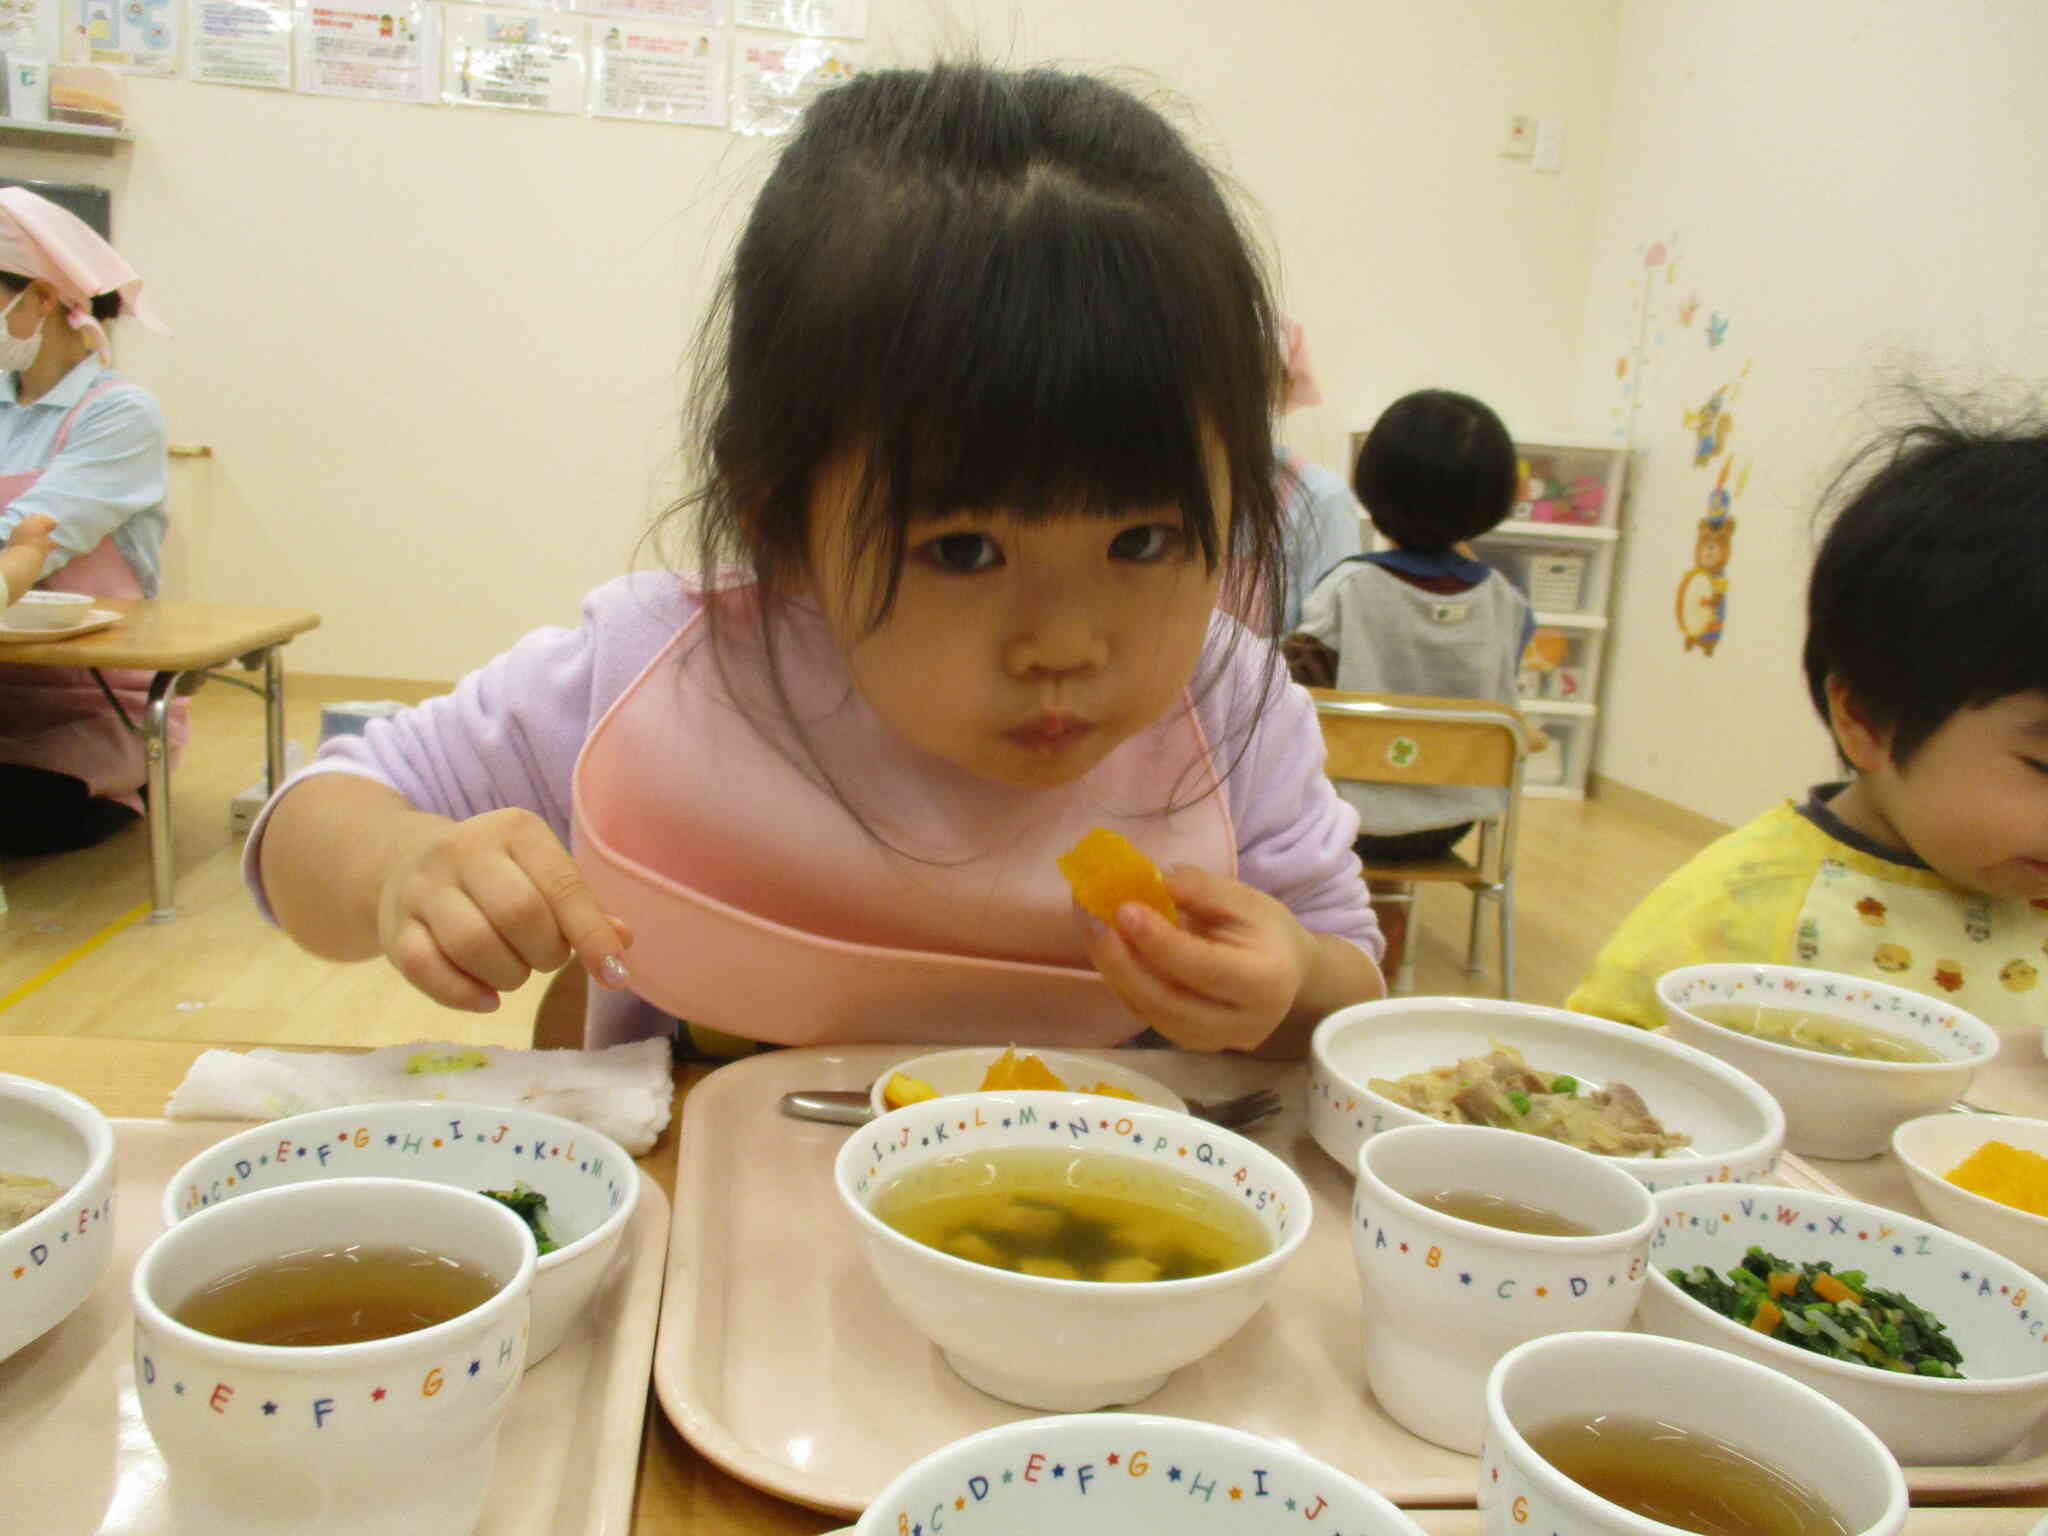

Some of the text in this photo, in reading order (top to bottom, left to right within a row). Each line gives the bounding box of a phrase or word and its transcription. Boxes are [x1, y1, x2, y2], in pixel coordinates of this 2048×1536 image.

[235, 1160, 251, 1179] D
[276, 1140, 292, 1162] E
[317, 1144, 332, 1167] F
[353, 1128, 370, 1148] G
[402, 1133, 423, 1153] H
[449, 1120, 464, 1140] I
[491, 1124, 511, 1144] J
[534, 1141, 547, 1160] K
[565, 1139, 577, 1160] L
[901, 1128, 910, 1148] J
[936, 1122, 949, 1144] K
[975, 1107, 988, 1126] L
[1019, 1106, 1038, 1126] M
[1068, 1117, 1089, 1139] N
[1115, 1118, 1133, 1135] O
[1154, 1137, 1168, 1152] P
[1196, 1143, 1213, 1165] Q
[1232, 1167, 1248, 1186] R
[1256, 1191, 1267, 1210] S
[30, 1244, 48, 1266] D
[79, 1209, 88, 1233] E
[1375, 1228, 1641, 1299] A B C D E
[1673, 1211, 1688, 1229] T
[1705, 1216, 1718, 1236] U
[1741, 1199, 1753, 1217] V
[1777, 1205, 1800, 1226] W
[1827, 1216, 1846, 1235] X
[1878, 1224, 1894, 1241] Y
[1978, 1277, 1992, 1296] A
[2011, 1288, 2028, 1308] B
[143, 1338, 513, 1429] D E F G H
[931, 1504, 944, 1532] C
[968, 1476, 989, 1501] D
[1024, 1453, 1046, 1483] E
[1077, 1465, 1094, 1495] F
[1128, 1451, 1149, 1477] G
[1189, 1472, 1216, 1502] H
[1252, 1469, 1269, 1496] I
[1305, 1495, 1328, 1520] J
[1512, 1496, 1528, 1524] G
